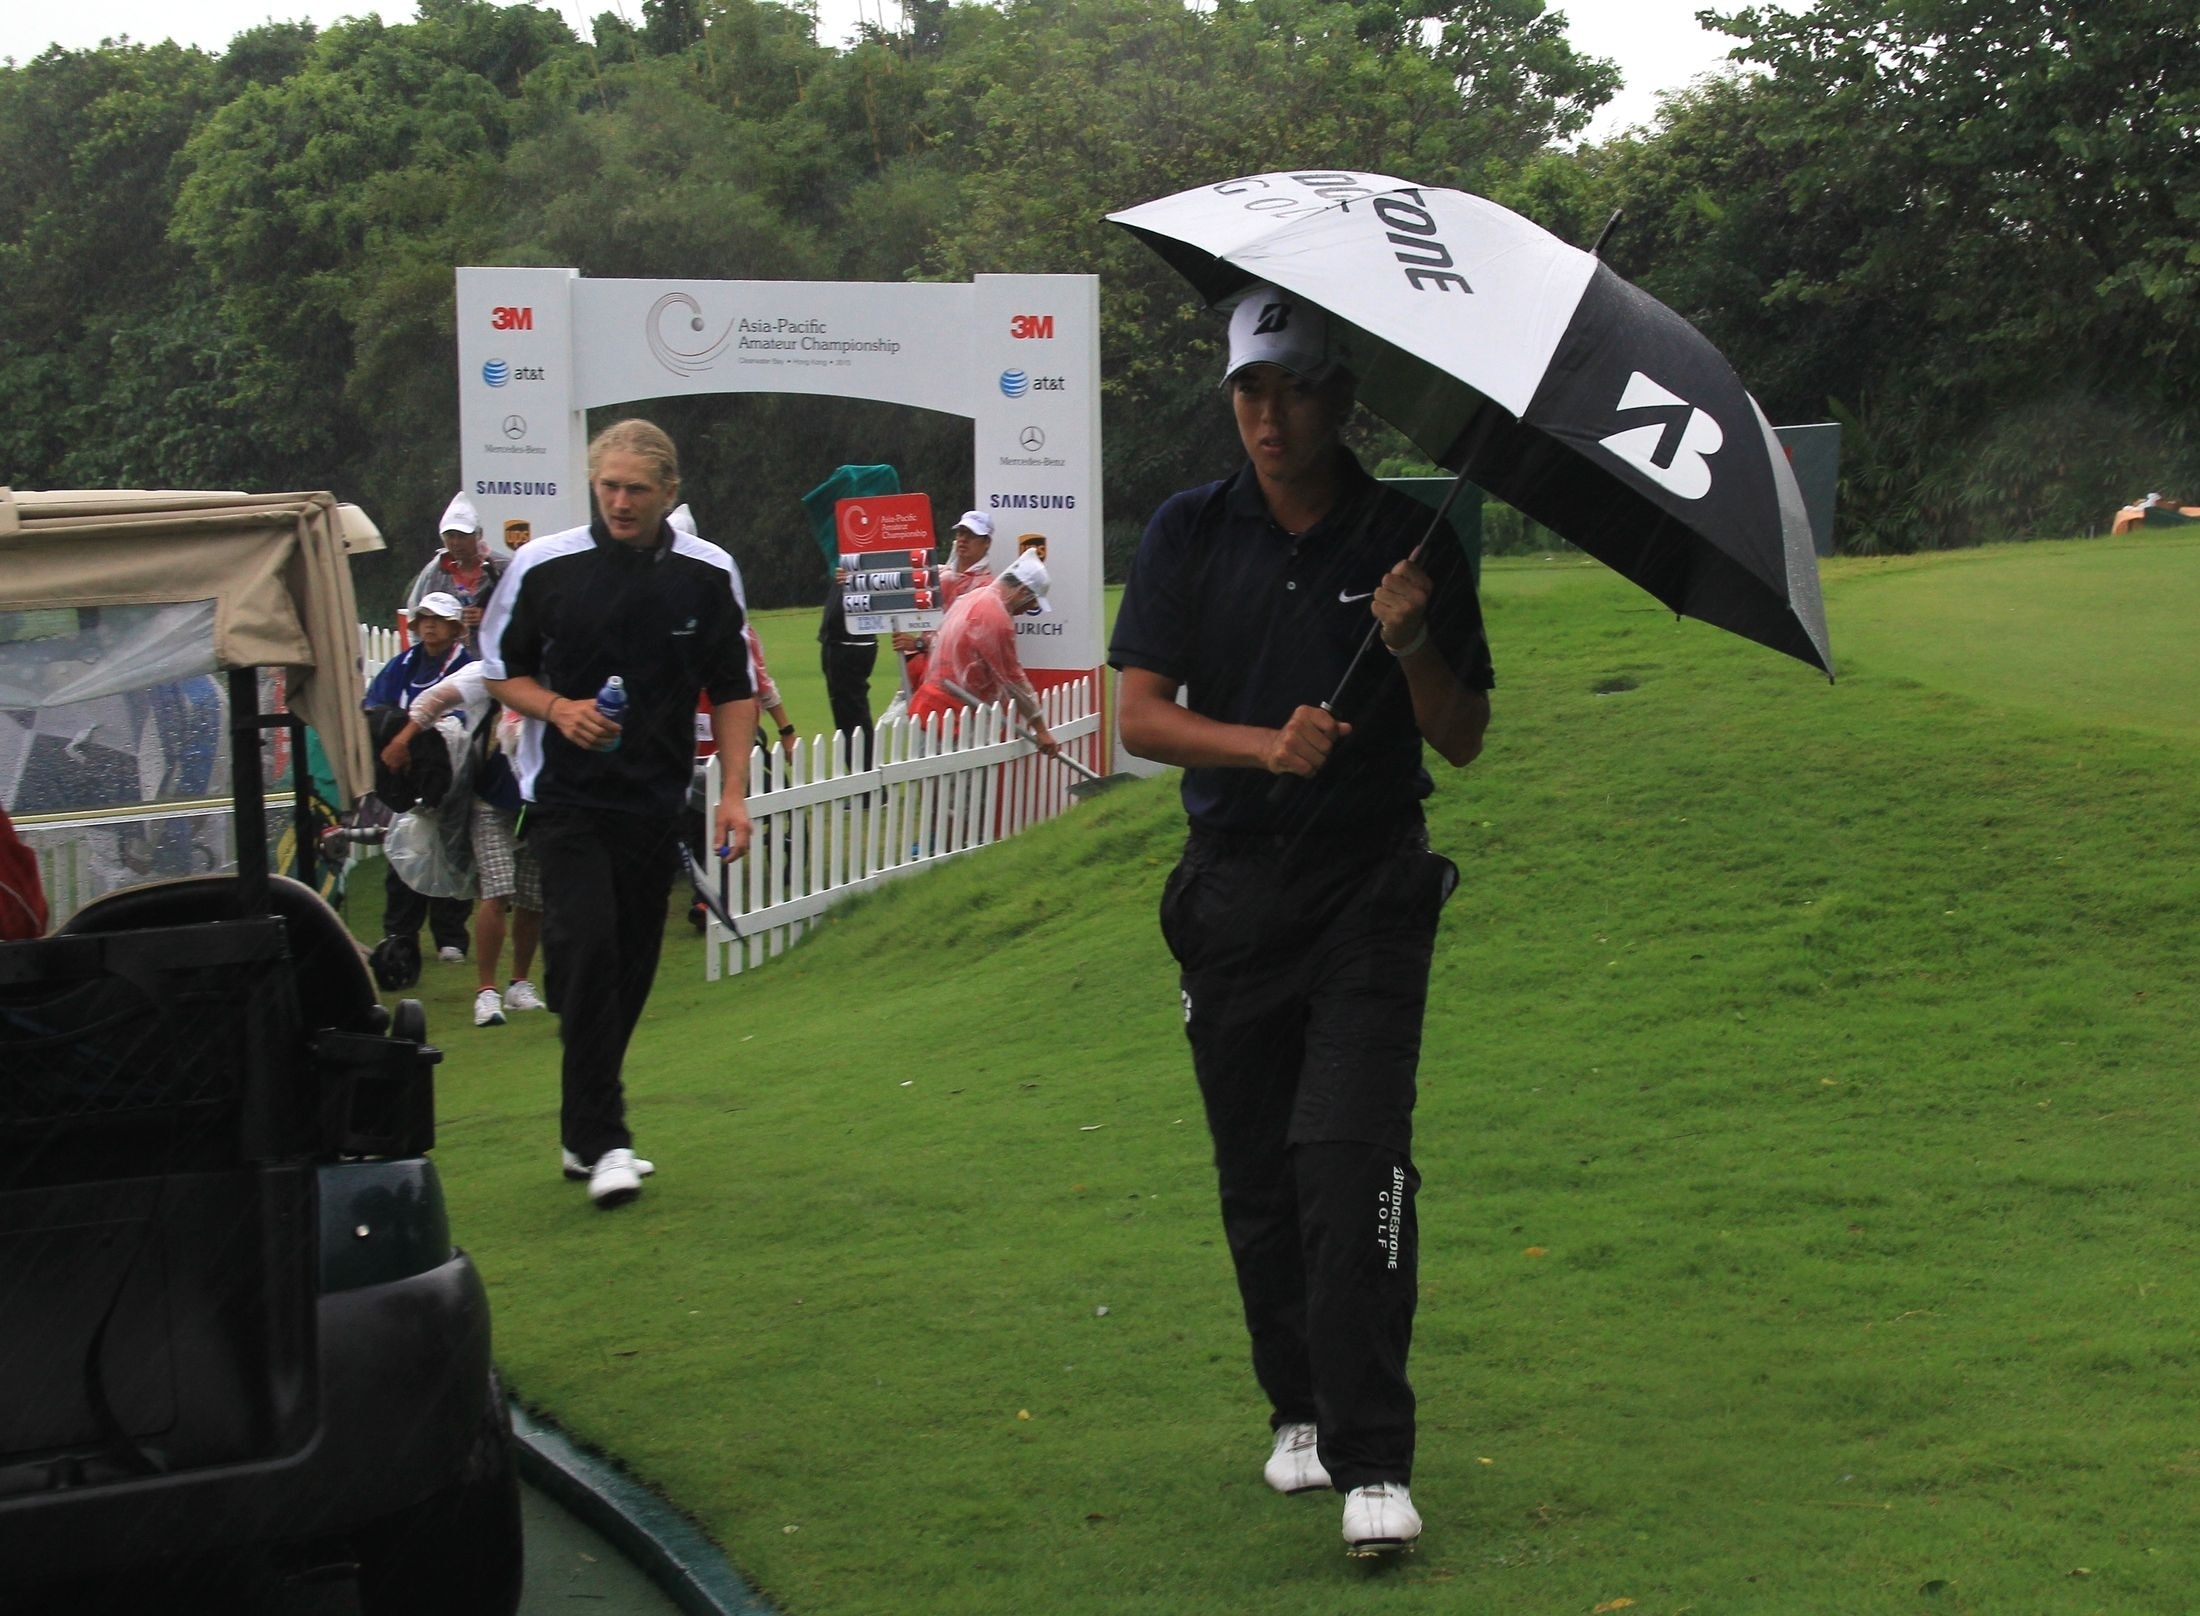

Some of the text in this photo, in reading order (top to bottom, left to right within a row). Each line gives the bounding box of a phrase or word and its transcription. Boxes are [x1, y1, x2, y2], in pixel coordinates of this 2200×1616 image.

[491, 307, 533, 330] 3M
[738, 318, 827, 334] Asia-Pacific
[1010, 315, 1054, 339] 3M
[738, 336, 901, 354] Amateur Championship
[514, 366, 544, 380] at&t
[1033, 376, 1065, 390] at&t
[484, 445, 547, 455] Mercedes-Benz
[1000, 457, 1065, 466] Mercedes-Benz
[476, 481, 557, 496] SAMSUNG
[990, 494, 1075, 509] SAMSUNG
[1014, 622, 1063, 636] URICH
[1378, 1191, 1389, 1249] GOLF
